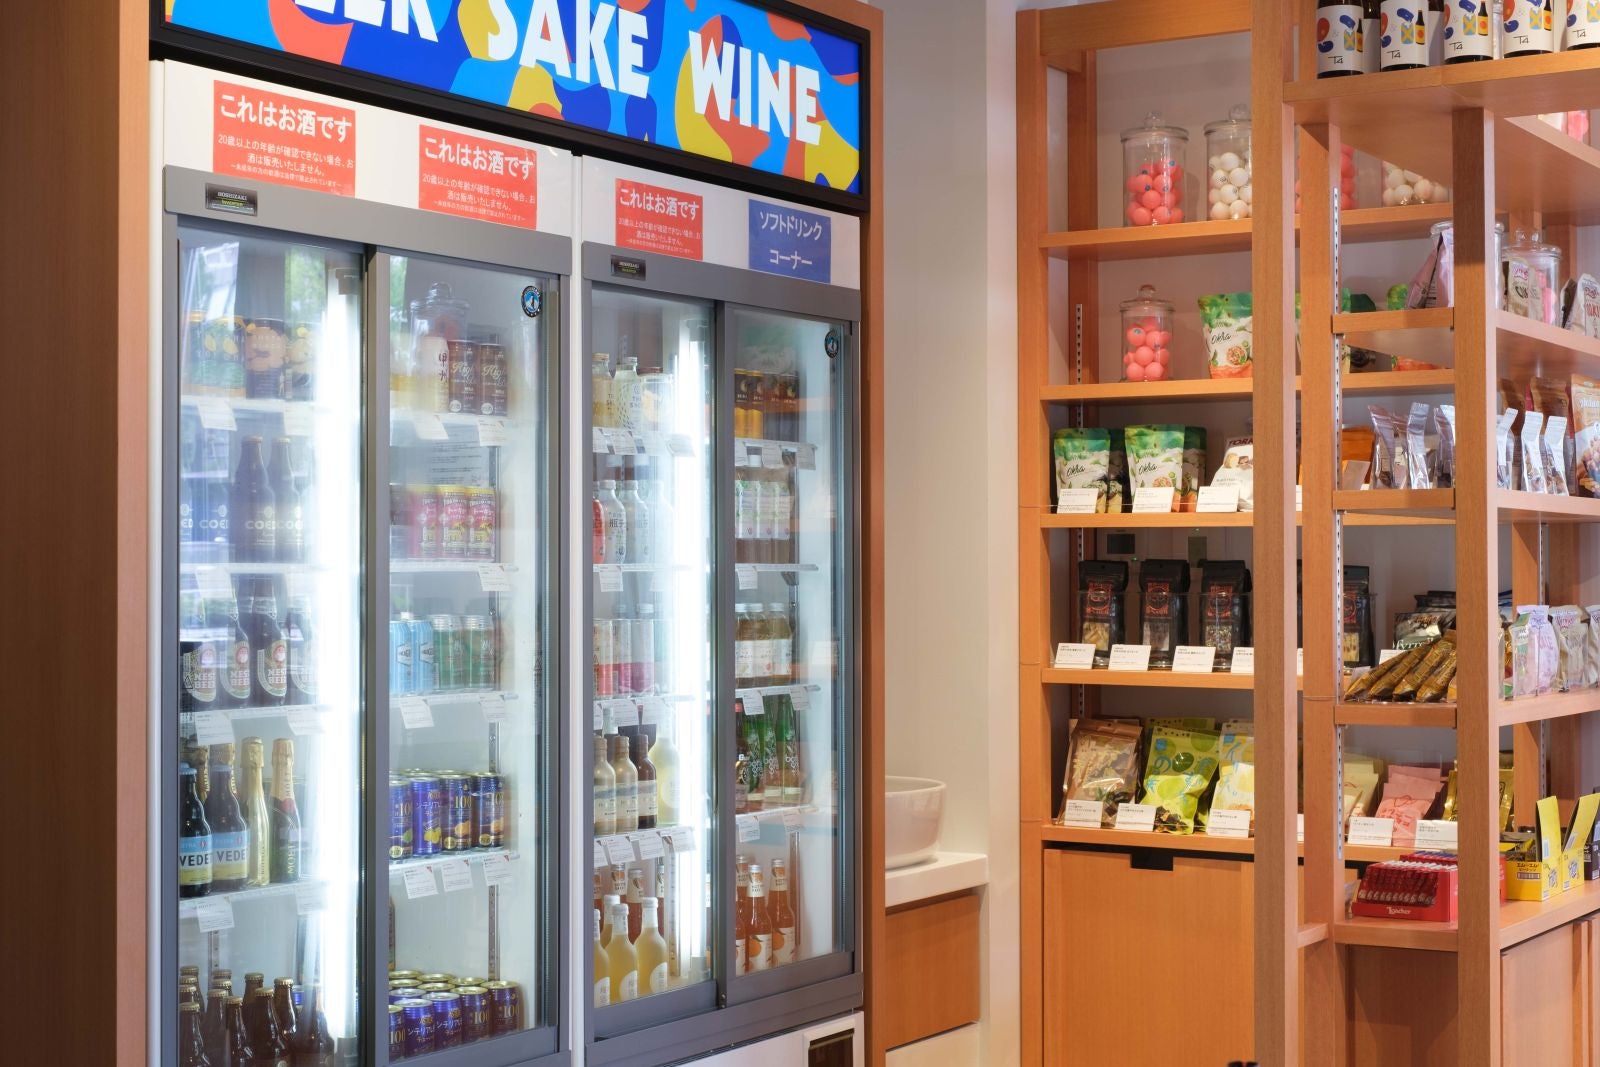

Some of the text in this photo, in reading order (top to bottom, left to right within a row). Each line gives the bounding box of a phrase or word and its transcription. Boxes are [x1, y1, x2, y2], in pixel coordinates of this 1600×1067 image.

[1513, 34, 1530, 45] T4
[1572, 28, 1587, 38] T4
[1386, 49, 1401, 60] T4
[1449, 41, 1464, 51] T4
[1328, 55, 1344, 65] T4
[487, 0, 820, 145] SAKE WINE
[221, 95, 352, 143] これはお酒です
[218, 134, 354, 169] 20歳以上の年齢が確認できない場合、お
[424, 138, 534, 181] これはお酒です
[247, 152, 325, 177] 酒は販売いたしません。
[447, 190, 512, 211] 酒は販売いたしません。
[620, 188, 700, 221] これはお酒です
[760, 211, 823, 241] ソフトドリンク
[769, 249, 813, 270] コーナー
